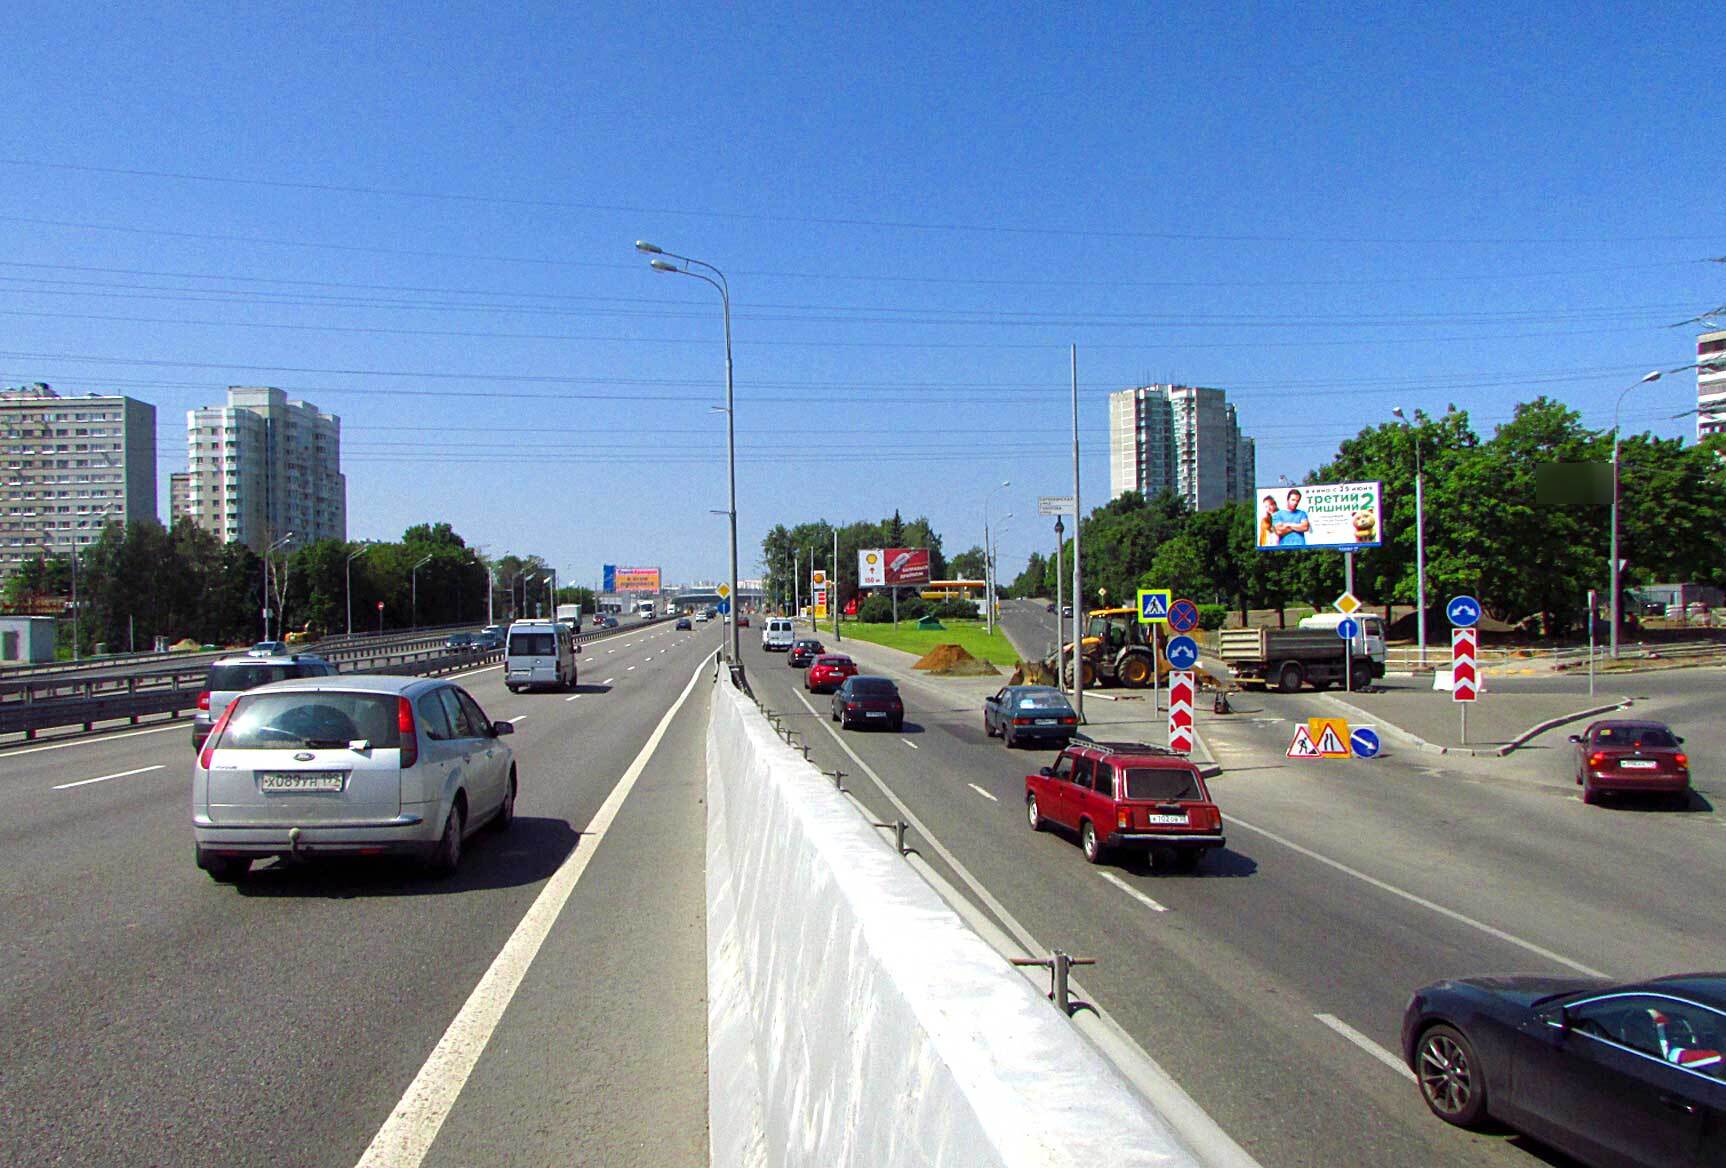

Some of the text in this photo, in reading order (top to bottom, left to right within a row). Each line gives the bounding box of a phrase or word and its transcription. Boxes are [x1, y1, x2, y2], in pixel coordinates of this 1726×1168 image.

[1307, 493, 1359, 506] третий
[1360, 492, 1375, 511] 2
[1308, 502, 1359, 513] лишний
